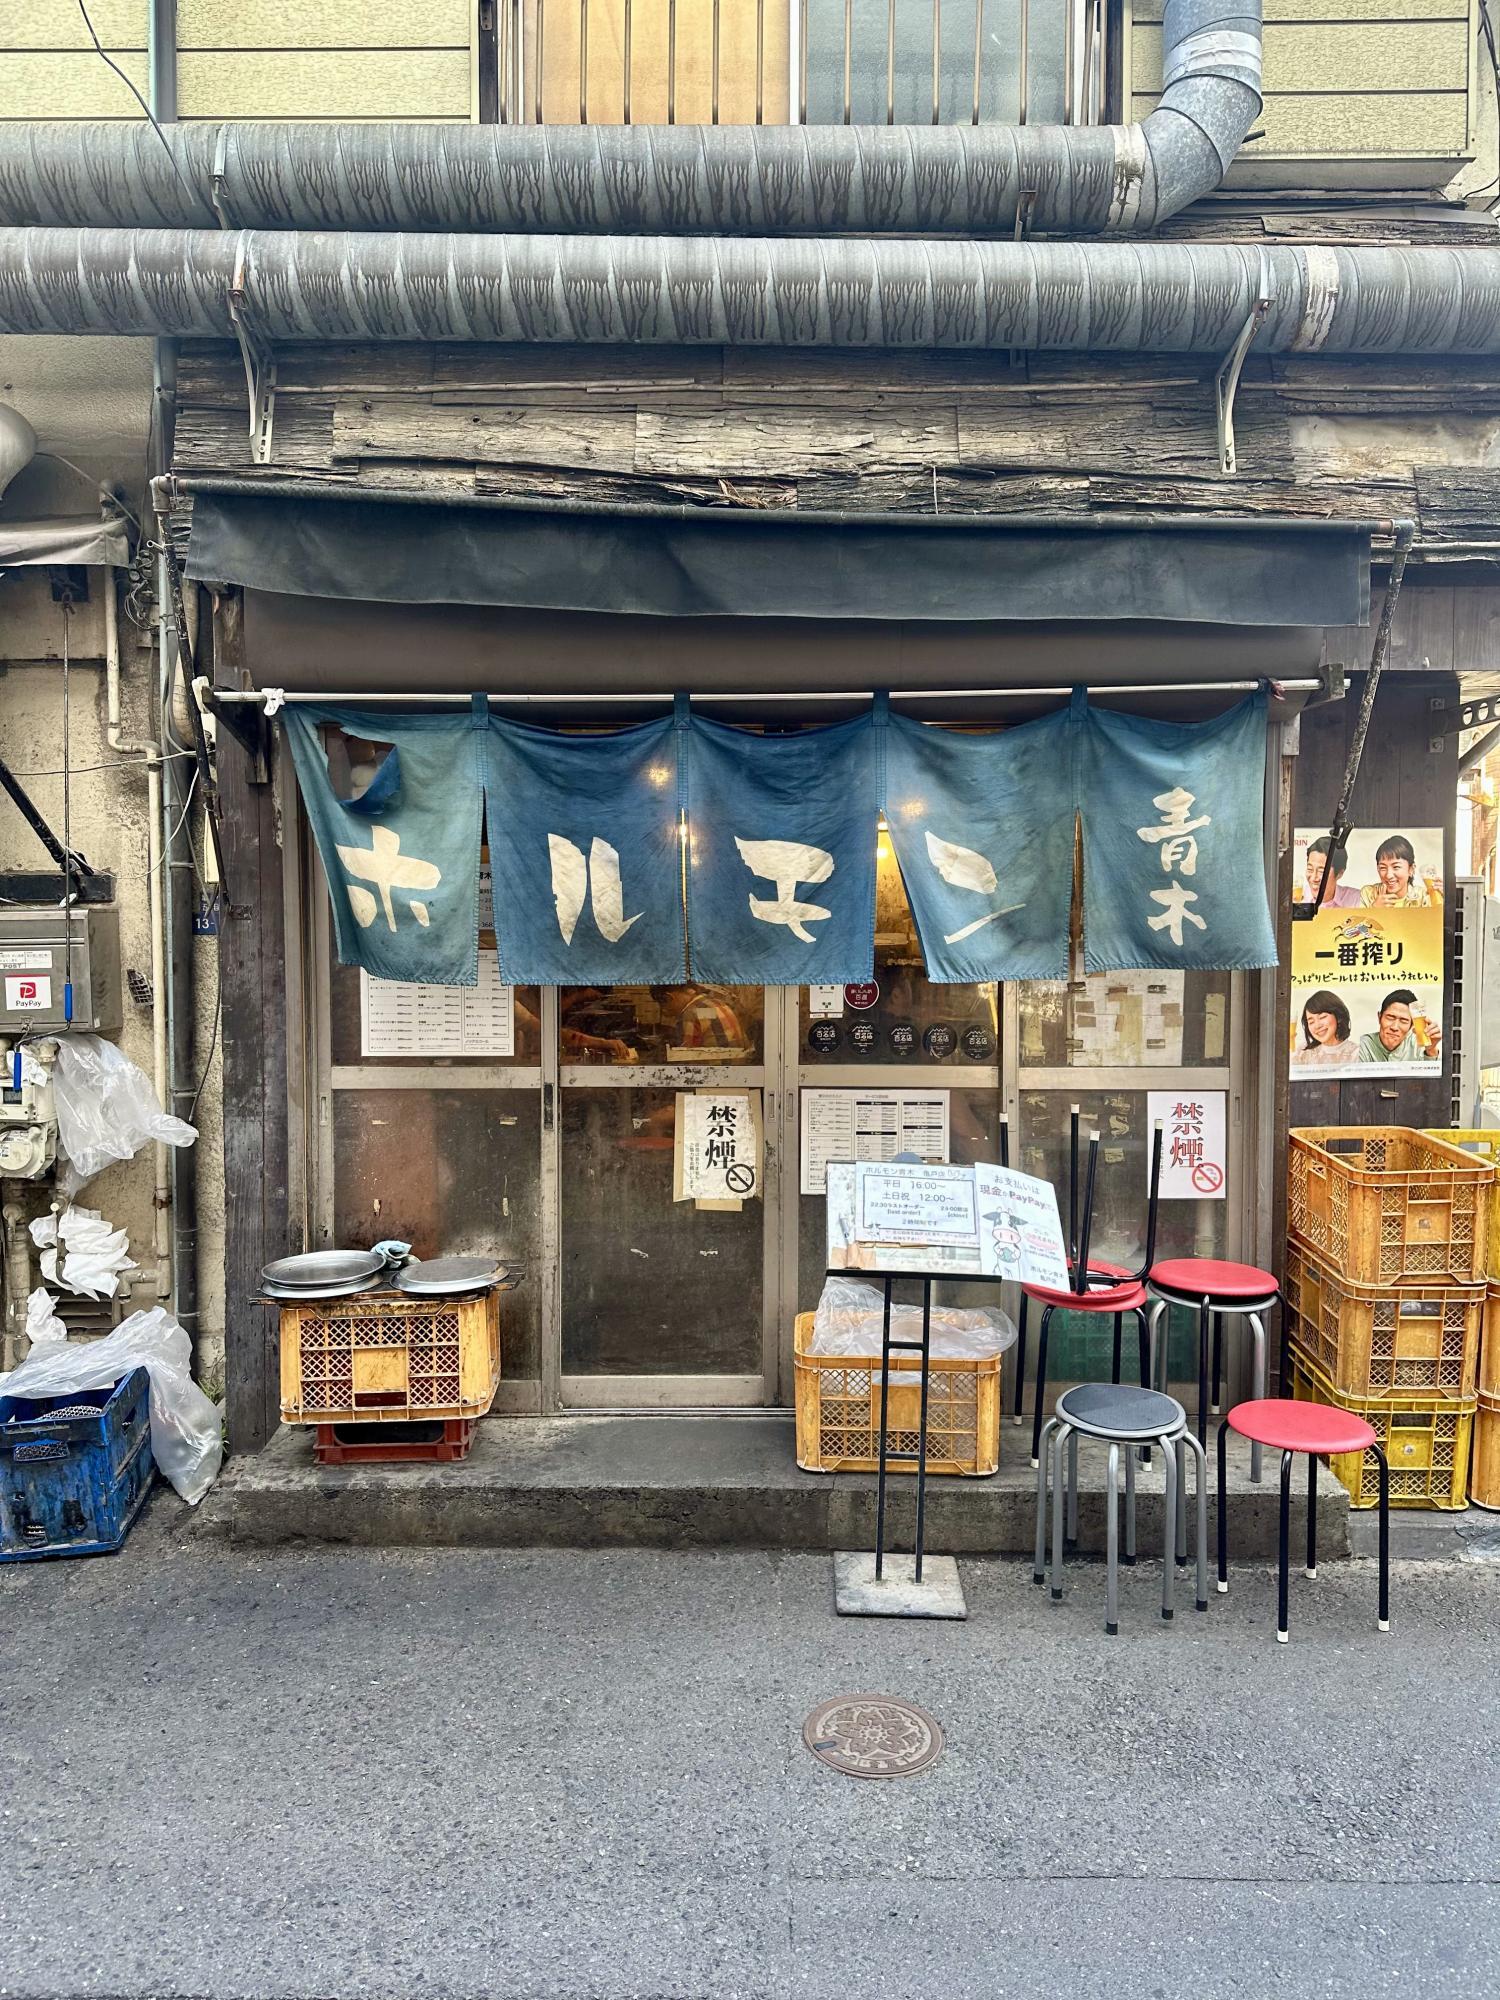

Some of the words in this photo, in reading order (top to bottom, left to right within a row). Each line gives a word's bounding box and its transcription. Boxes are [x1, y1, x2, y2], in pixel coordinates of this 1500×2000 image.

[1137, 786, 1212, 947] 青木
[1315, 942, 1404, 967] 一番搾り
[705, 1105, 737, 1170] 禁煙
[1170, 1102, 1204, 1169] 禁煙
[865, 1167, 915, 1177] ホルモン青木
[883, 1179, 901, 1188] 平日
[881, 1191, 910, 1201] 土日祝
